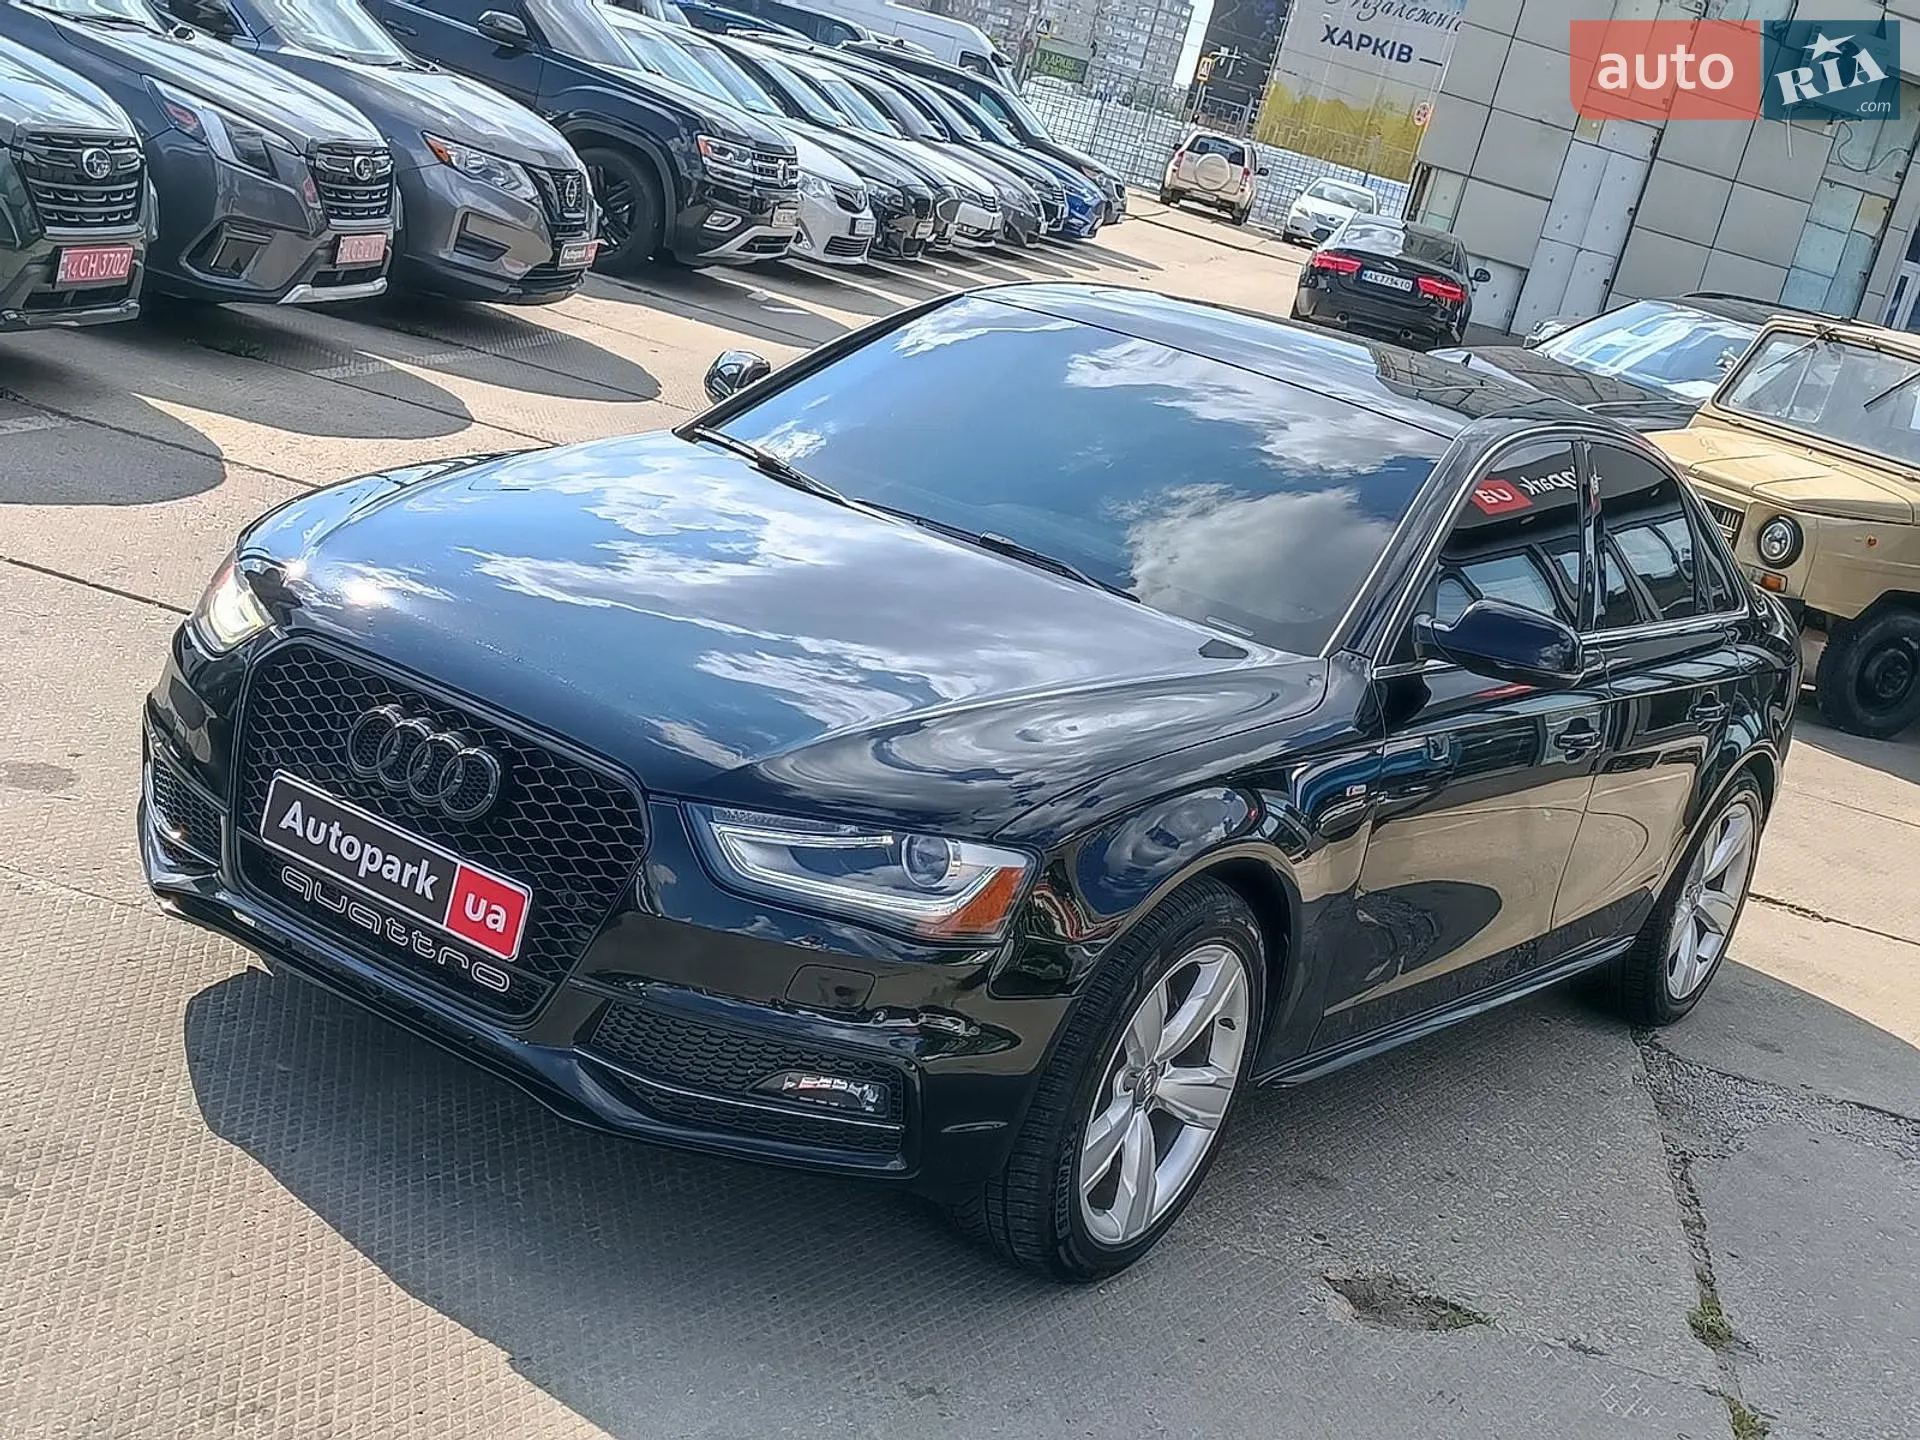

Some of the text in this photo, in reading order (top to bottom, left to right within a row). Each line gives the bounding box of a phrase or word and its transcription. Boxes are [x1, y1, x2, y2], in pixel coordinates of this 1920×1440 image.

[1320, 24, 1414, 63] ХАРКІВ
[100, 252, 128, 276] 3702
[279, 801, 507, 933] Autopark ua
[281, 865, 509, 993] quattro
